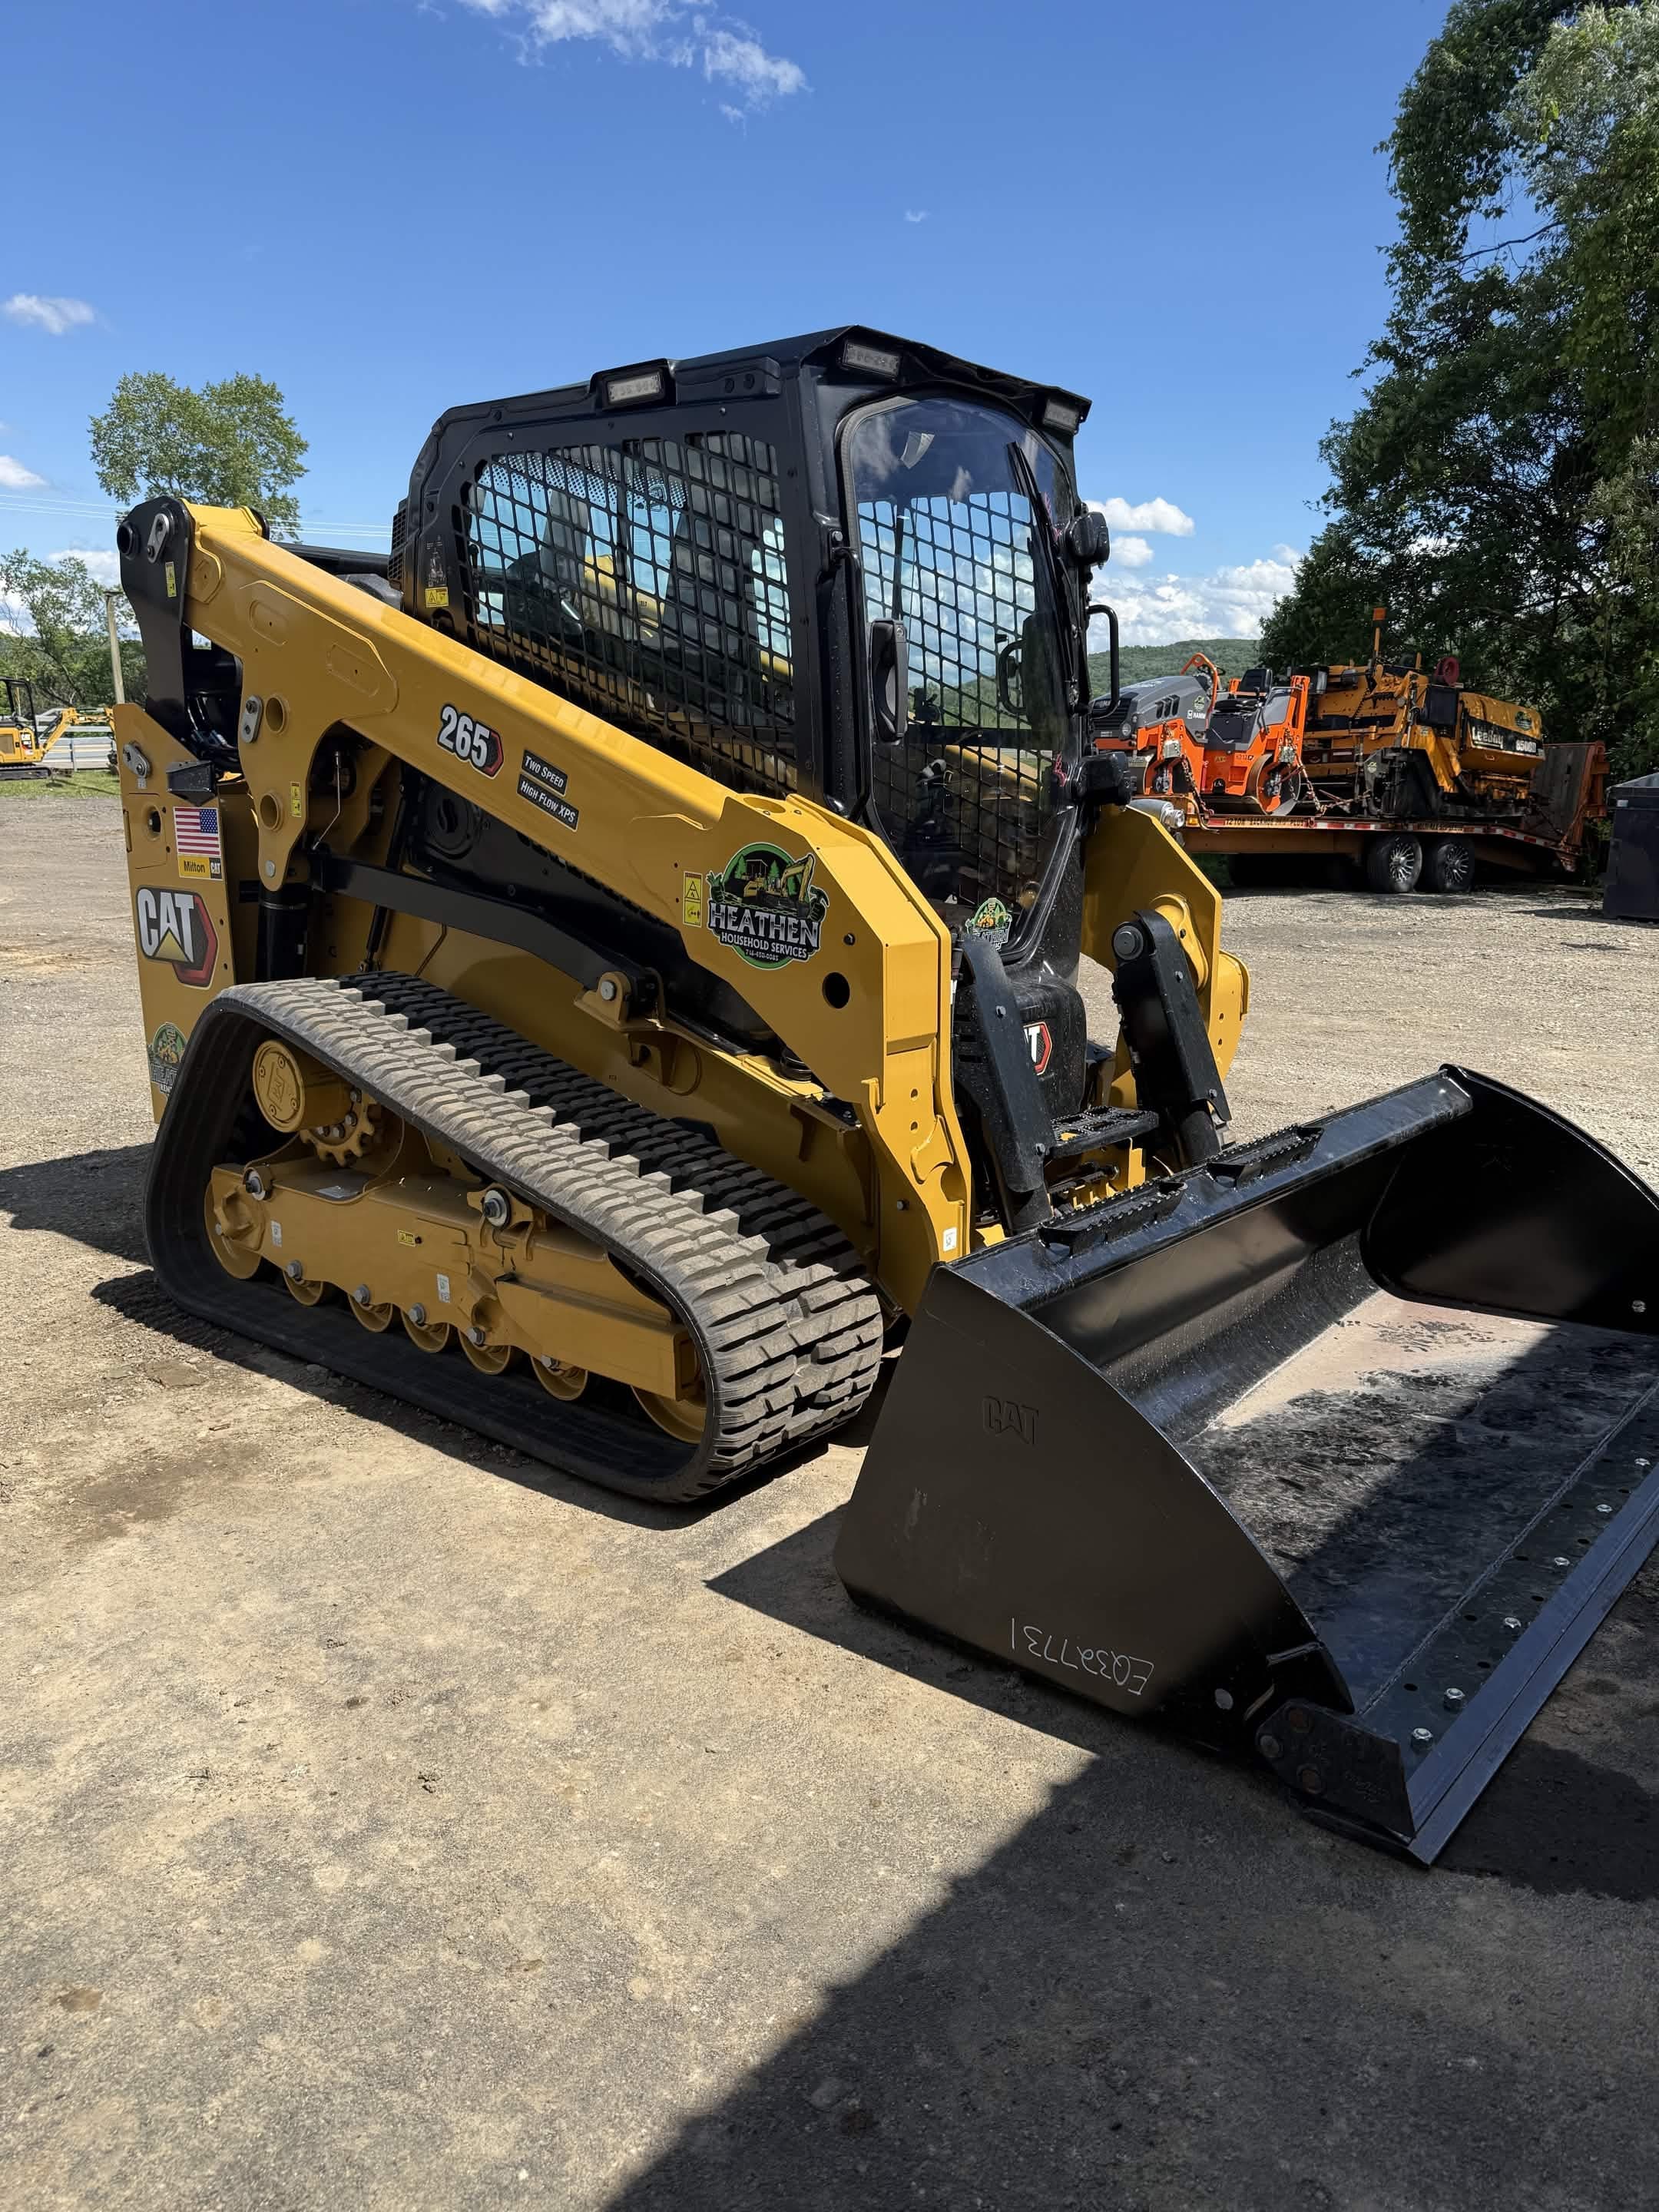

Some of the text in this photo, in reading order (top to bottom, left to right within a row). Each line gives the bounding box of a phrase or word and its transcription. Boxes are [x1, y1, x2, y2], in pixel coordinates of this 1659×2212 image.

[439, 705, 490, 767] 265
[525, 755, 565, 788] TWO SPEED
[520, 780, 576, 823] HIGH FLOW XPS
[184, 859, 222, 874] Milton CAT
[137, 888, 194, 963] CAT
[710, 902, 819, 948] HEATHEN
[720, 932, 807, 959] HOUSEHOLD SERVICES
[983, 1395, 1039, 1445] CAT
